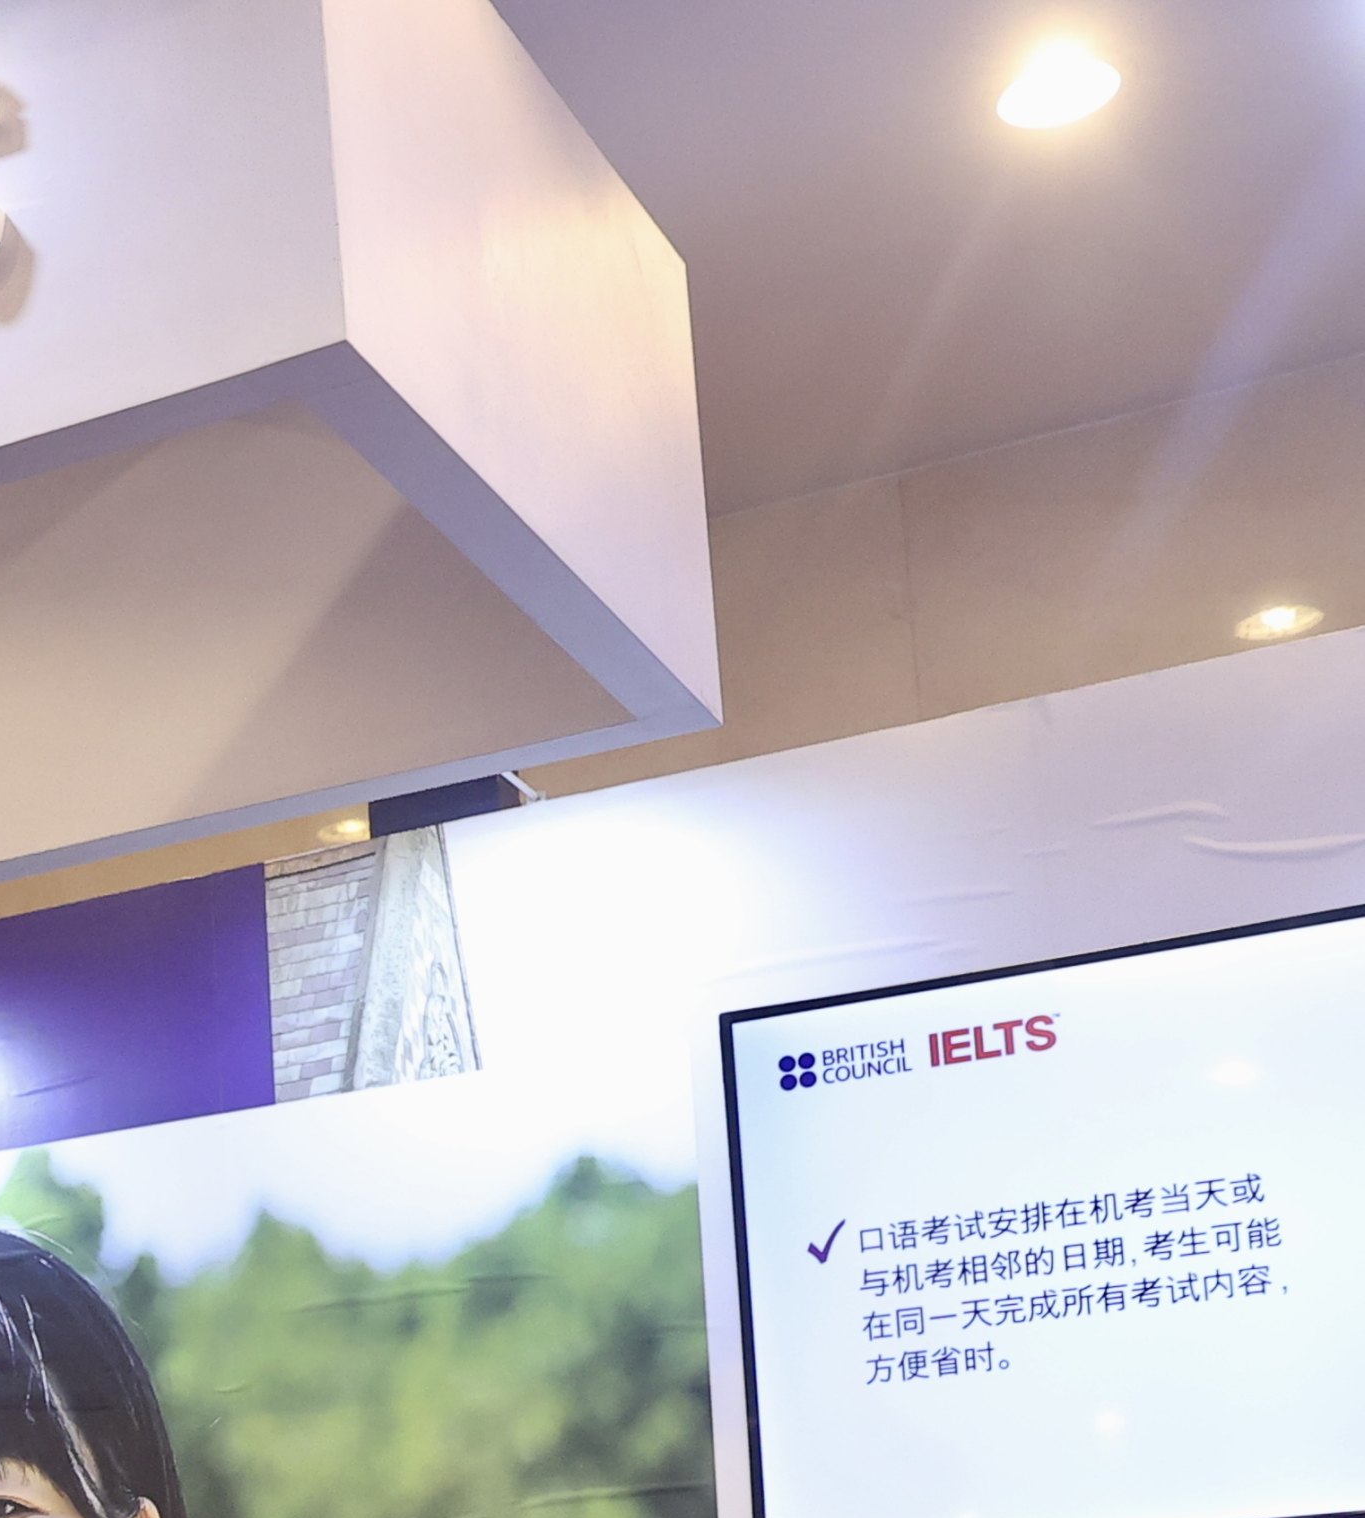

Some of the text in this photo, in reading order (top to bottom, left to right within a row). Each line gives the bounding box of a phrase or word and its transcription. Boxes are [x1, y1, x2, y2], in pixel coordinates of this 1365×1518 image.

[822, 1038, 906, 1067] BRITISH
[928, 1014, 1058, 1067] IELTS
[822, 1056, 913, 1085] COUNCIL
[858, 1172, 1266, 1254] 口语考试安排在机考当天或
[865, 1341, 1012, 1386] 方便省时。
